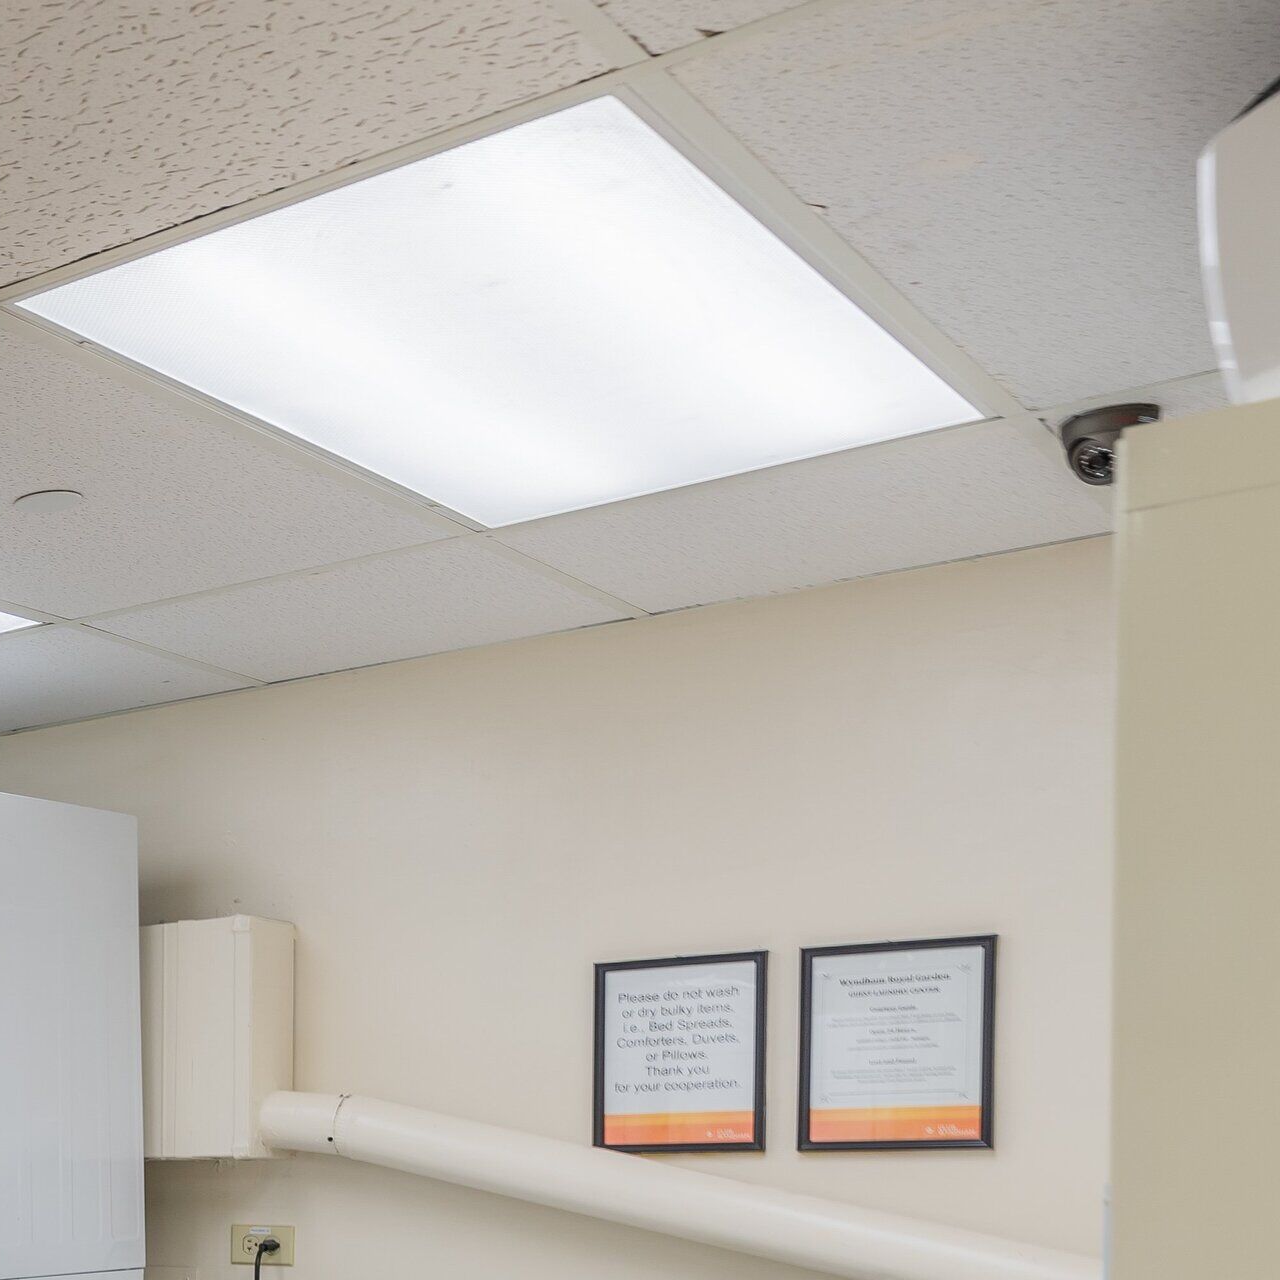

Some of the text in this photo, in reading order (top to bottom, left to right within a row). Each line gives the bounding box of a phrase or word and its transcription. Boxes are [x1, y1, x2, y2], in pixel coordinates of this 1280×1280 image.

[618, 986, 739, 1003] Please do not wash
[622, 1009, 633, 1018] or
[638, 1007, 656, 1019] dry
[661, 1005, 692, 1018] bulky
[649, 1021, 673, 1032] Bed
[646, 1052, 657, 1062] or
[646, 1065, 709, 1076] Thank you
[615, 1082, 629, 1093] for
[634, 1083, 660, 1094] your
